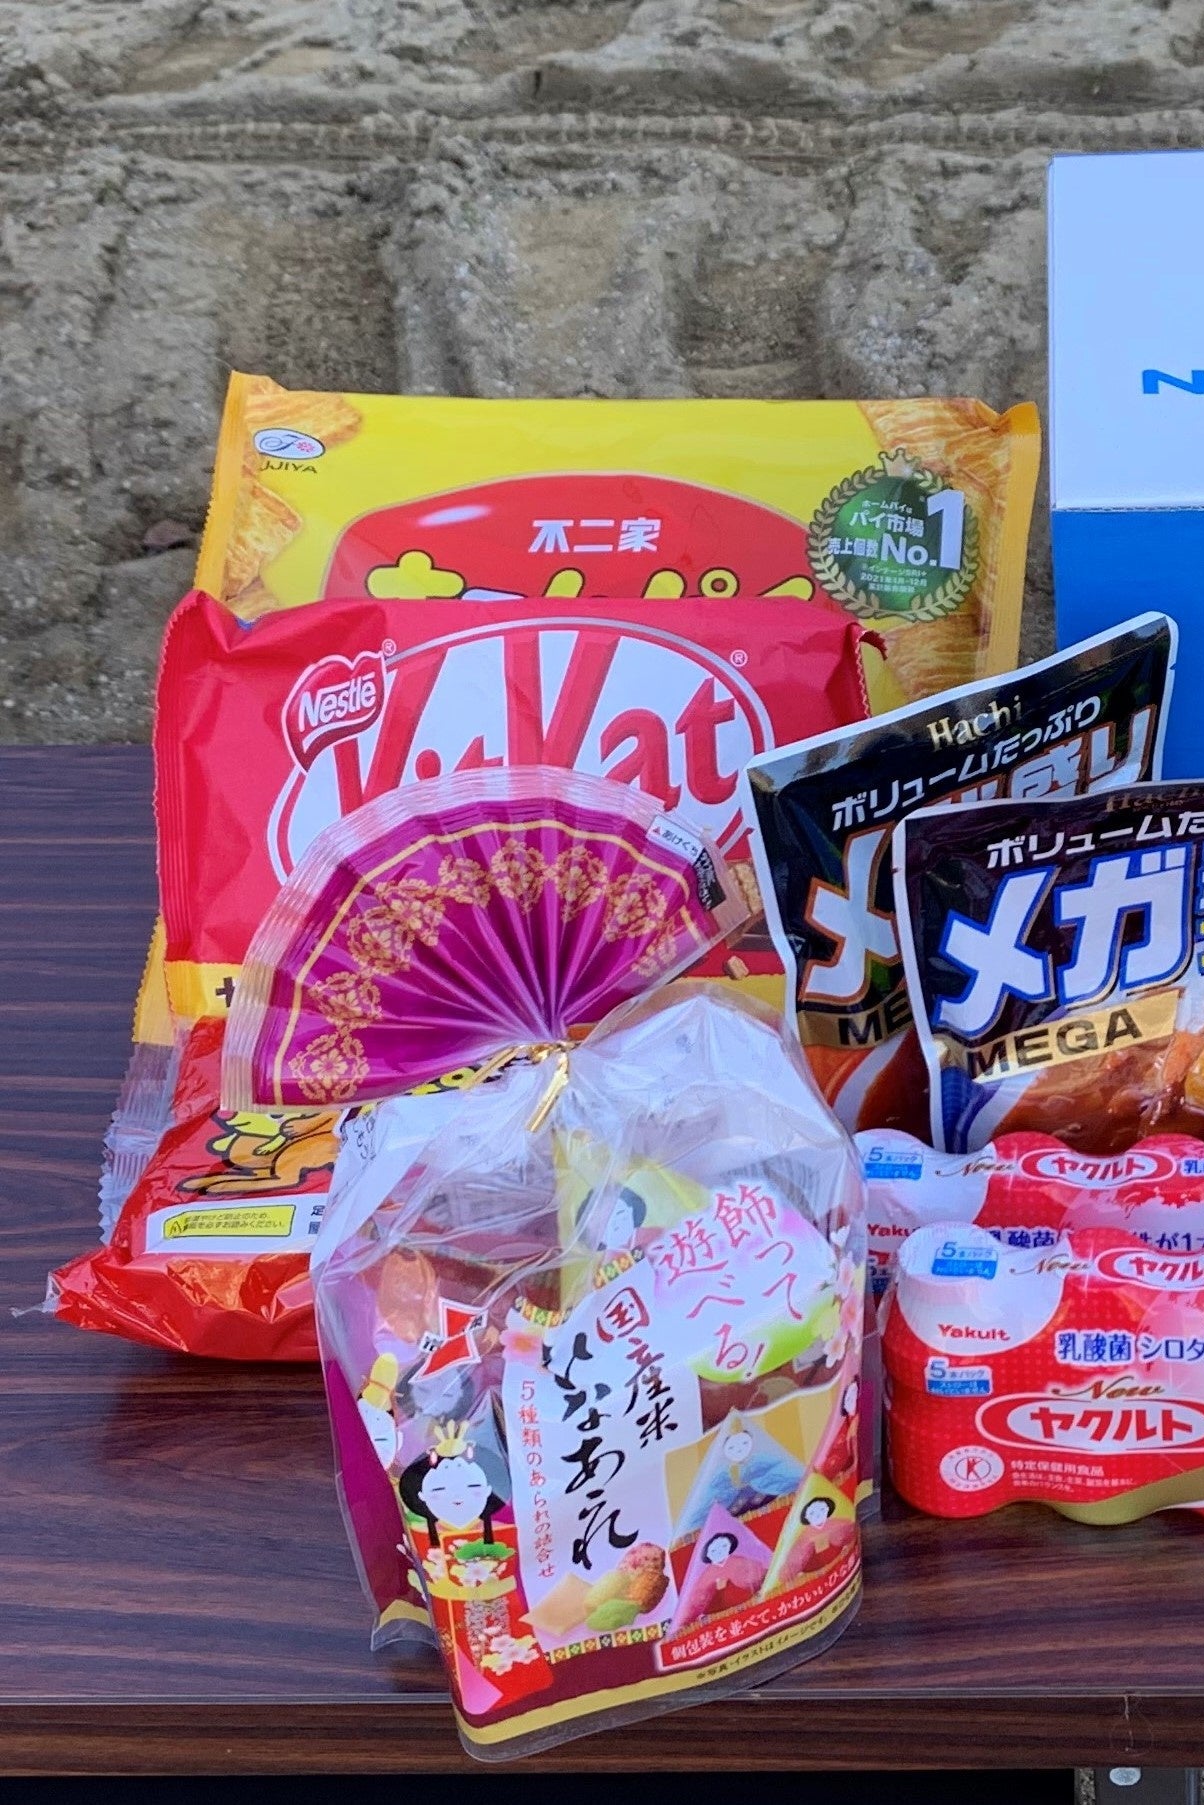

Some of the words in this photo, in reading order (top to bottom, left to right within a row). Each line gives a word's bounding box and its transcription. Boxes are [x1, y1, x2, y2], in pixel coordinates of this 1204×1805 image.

[528, 516, 662, 553] 不二家
[849, 511, 925, 538] パイ市場
[926, 696, 1024, 751] Hachi
[831, 695, 1102, 831] ボリュームたっぷり
[965, 1006, 1144, 1080] MEGA
[1051, 1154, 1147, 1182] ヤクルト
[866, 1223, 922, 1237] Yaku
[713, 1183, 804, 1321] 飾って
[938, 1323, 1012, 1341] Yakult
[1057, 1332, 1132, 1363] 乳酸菌
[595, 1286, 679, 1450] 国産米
[1029, 1406, 1193, 1442] ヤクルト
[541, 1332, 640, 1571] ひなあられ
[1010, 1459, 1105, 1477] 特定保健用食品
